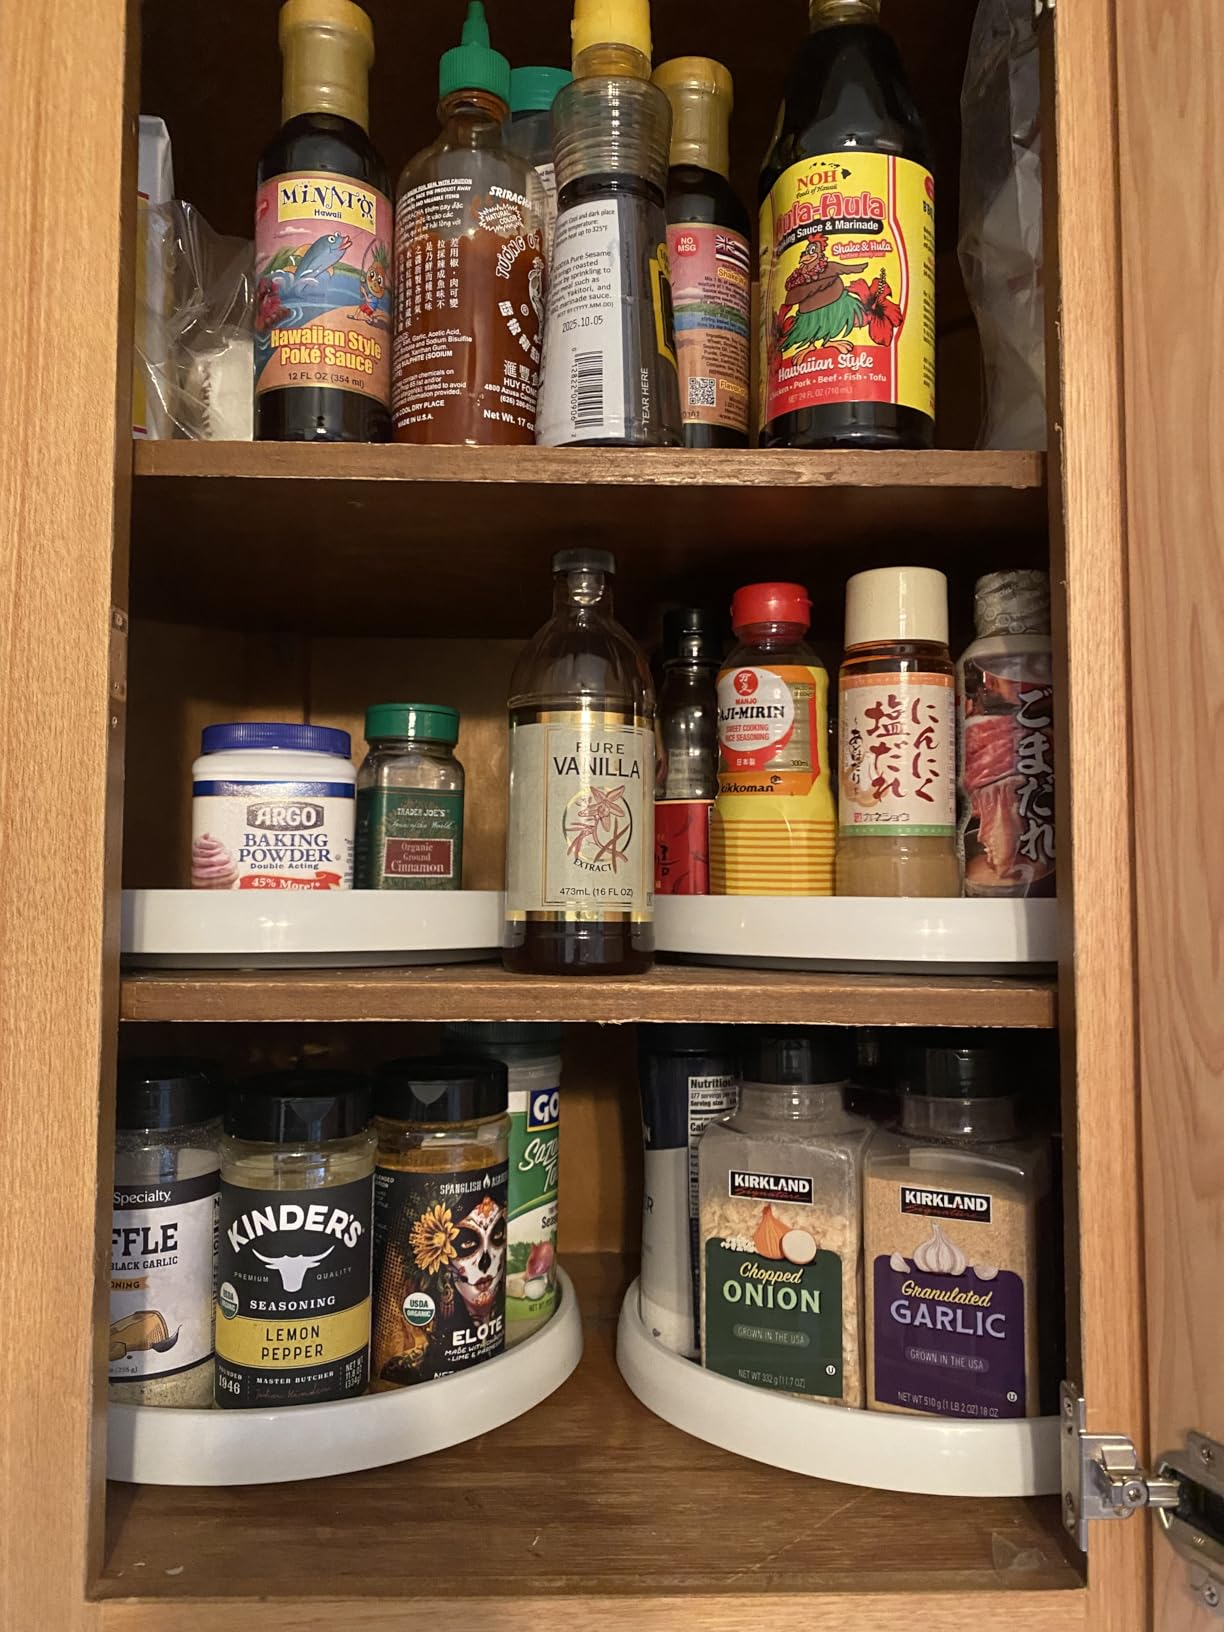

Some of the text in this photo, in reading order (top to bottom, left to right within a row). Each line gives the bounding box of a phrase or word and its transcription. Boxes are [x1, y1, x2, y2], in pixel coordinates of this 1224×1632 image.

[797, 170, 837, 191] NOH
[314, 209, 342, 219] Hawaii
[485, 210, 511, 222] NATURAL
[499, 214, 517, 224] COLOR
[797, 224, 823, 238] Sauce
[825, 222, 833, 231] &
[835, 220, 878, 230] Marinade
[584, 250, 612, 259] Sesame
[678, 244, 697, 252] MSG
[833, 240, 892, 254] Shake & Hula
[573, 260, 598, 270] roasted
[574, 278, 590, 286] such
[597, 283, 611, 291] and
[562, 315, 604, 333] 2025.10.05
[271, 326, 345, 347] Hawaiian
[348, 332, 381, 360] Style
[426, 335, 473, 346] Sodium Bisulfite
[281, 345, 320, 365] Poké
[324, 351, 373, 375] Sauce
[778, 352, 874, 382] Hawaiian Style
[288, 373, 299, 381] 12
[300, 372, 312, 381] FL
[315, 372, 327, 381] OZ
[331, 373, 349, 385] (354
[449, 381, 467, 389] avoid
[504, 377, 520, 389] HUY
[640, 367, 649, 393] HERE
[793, 379, 811, 389] Pork
[818, 374, 837, 384] Beef
[844, 373, 862, 381] Fish
[868, 373, 887, 382] Tofu
[434, 388, 462, 397] provided.
[501, 387, 520, 397] Azusa
[411, 400, 445, 411] DRY PLACE
[641, 395, 650, 425] TEAR
[417, 413, 434, 422] U.S.A.
[484, 409, 526, 427] Net Wt. 17
[720, 705, 785, 720] AJI-MIRIN
[726, 724, 769, 733] SWEET COOKING
[735, 733, 770, 741] SEASONING
[576, 742, 625, 755] PURE
[864, 694, 911, 802] 塩だれ
[911, 698, 940, 802] にんにく
[554, 756, 640, 779] VANILLA
[1016, 688, 1056, 862] ごまだれ
[254, 807, 316, 826] ARGO
[397, 808, 446, 817] TRADER JOE'S
[244, 834, 328, 848] BAKING
[401, 842, 433, 853] Organic
[238, 848, 332, 863] POWDER
[403, 853, 431, 861] Ground
[391, 860, 444, 872] Cinnamon
[573, 858, 612, 872] EXTRACT
[252, 878, 276, 888] 45%
[560, 888, 633, 897] 473mL (16 FL OZ)
[533, 1091, 559, 1123] GO
[690, 1100, 711, 1108] Serving
[440, 1180, 482, 1195] SPANGLISH
[734, 1173, 810, 1193] KIRKLAND
[113, 1190, 171, 1206] Specialty
[905, 1189, 988, 1212] KIRKLAND
[227, 1204, 363, 1253] KINDER'S
[143, 1256, 178, 1269] GARLIC
[234, 1266, 352, 1283] PREMIUM QUALITY
[740, 1262, 803, 1285] Chopped
[722, 1280, 820, 1314] ONION
[901, 1279, 993, 1308] Granulated
[250, 1296, 335, 1311] SEASONING
[410, 1300, 429, 1309] USDA
[407, 1309, 431, 1318] ORGANIC
[890, 1299, 1006, 1338] GARLIC
[266, 1325, 320, 1342] LEMON
[452, 1315, 502, 1346] ELOTE
[738, 1326, 804, 1344] GROWN IN THE USA
[262, 1344, 323, 1361] PEPPER
[444, 1347, 467, 1356] MADE
[451, 1354, 470, 1362] LIME
[910, 1349, 984, 1369] GROWN IN THE USA
[218, 1365, 243, 1380] FOUNDED
[256, 1370, 334, 1385] MASTER BUTCHER
[738, 1368, 750, 1379] NET
[751, 1372, 761, 1381] WT
[794, 1378, 806, 1388] OZ)
[218, 1374, 241, 1395] 1946
[898, 1391, 999, 1418] NET WT 510 LB 2 OZ) 18 OZ
